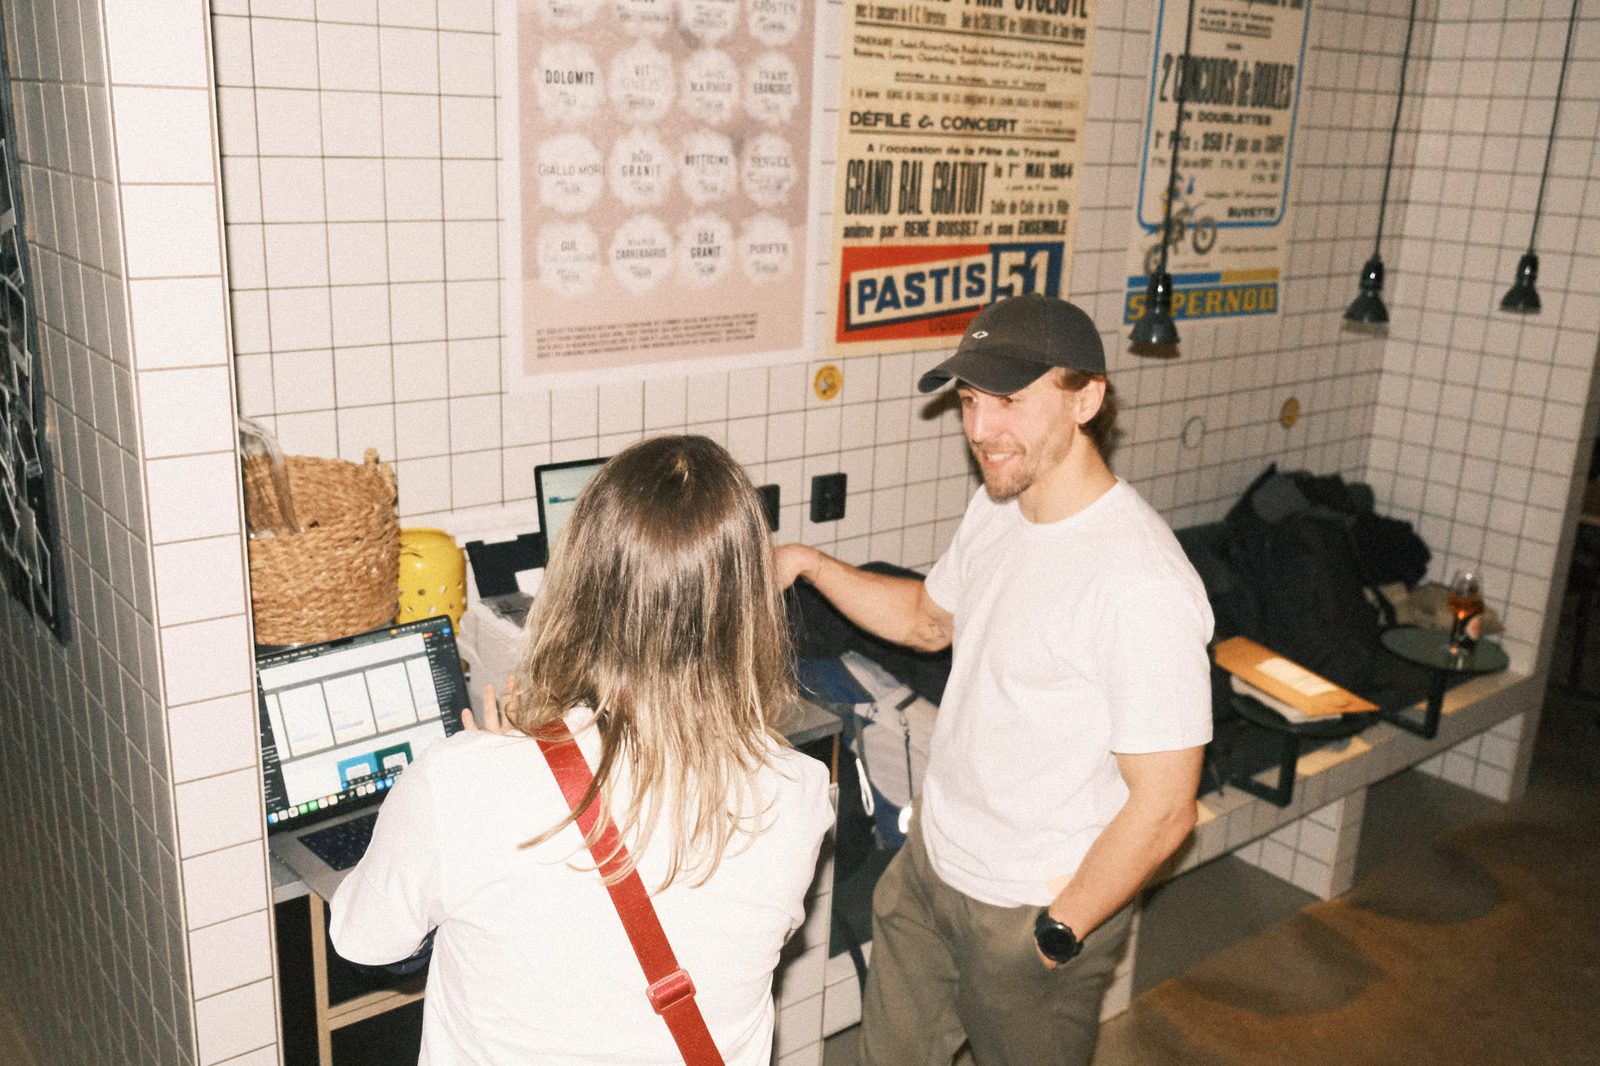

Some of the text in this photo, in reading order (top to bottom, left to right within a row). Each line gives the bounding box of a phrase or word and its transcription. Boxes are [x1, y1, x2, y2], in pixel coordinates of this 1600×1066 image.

[546, 69, 595, 86] DOLOMIT
[850, 110, 911, 129] DÉFILÉ
[941, 116, 1018, 132] CONCERT
[947, 145, 960, 156] de
[622, 165, 662, 177] GRANIT
[1025, 162, 1045, 179] MAI
[845, 159, 988, 215] GRAND BAL GRATUIT
[1018, 219, 1067, 236] ENSEMBLE
[857, 249, 1049, 316] PASTIS 51
[1128, 286, 1276, 321] SPERNOD
